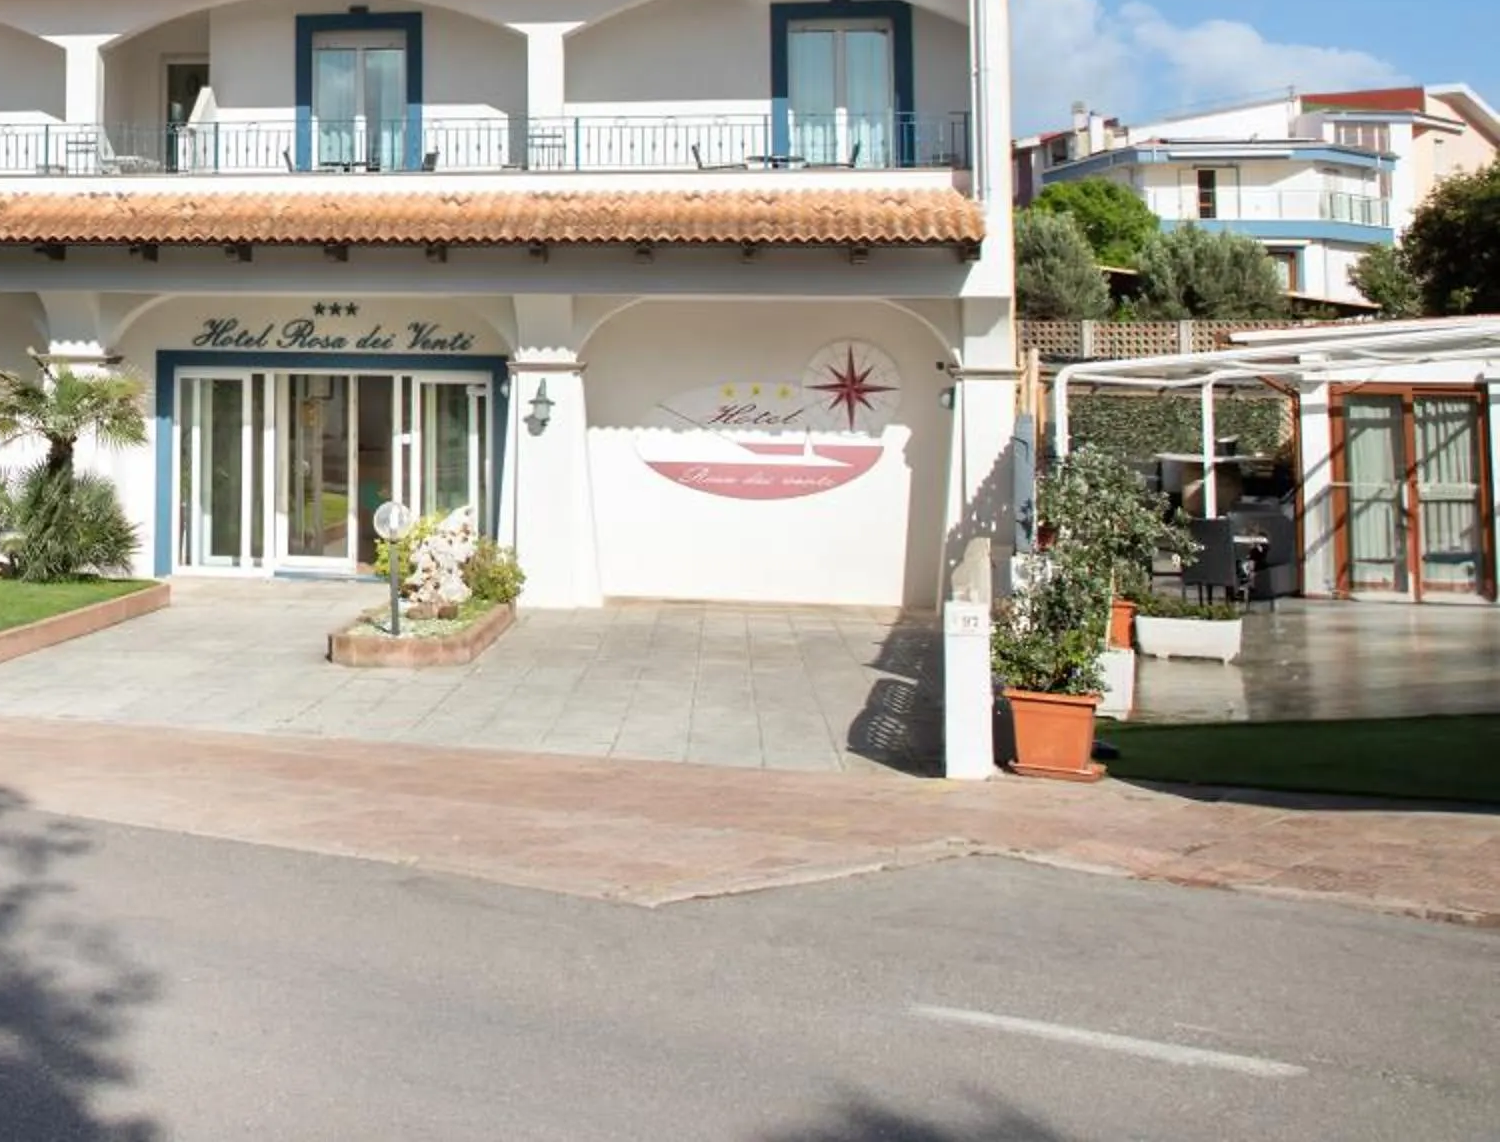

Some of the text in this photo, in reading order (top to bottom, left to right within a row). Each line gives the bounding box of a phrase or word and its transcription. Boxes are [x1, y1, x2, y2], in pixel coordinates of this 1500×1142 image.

[192, 318, 476, 351] Hotel Rosa dei Venti
[707, 403, 804, 425] Hotel
